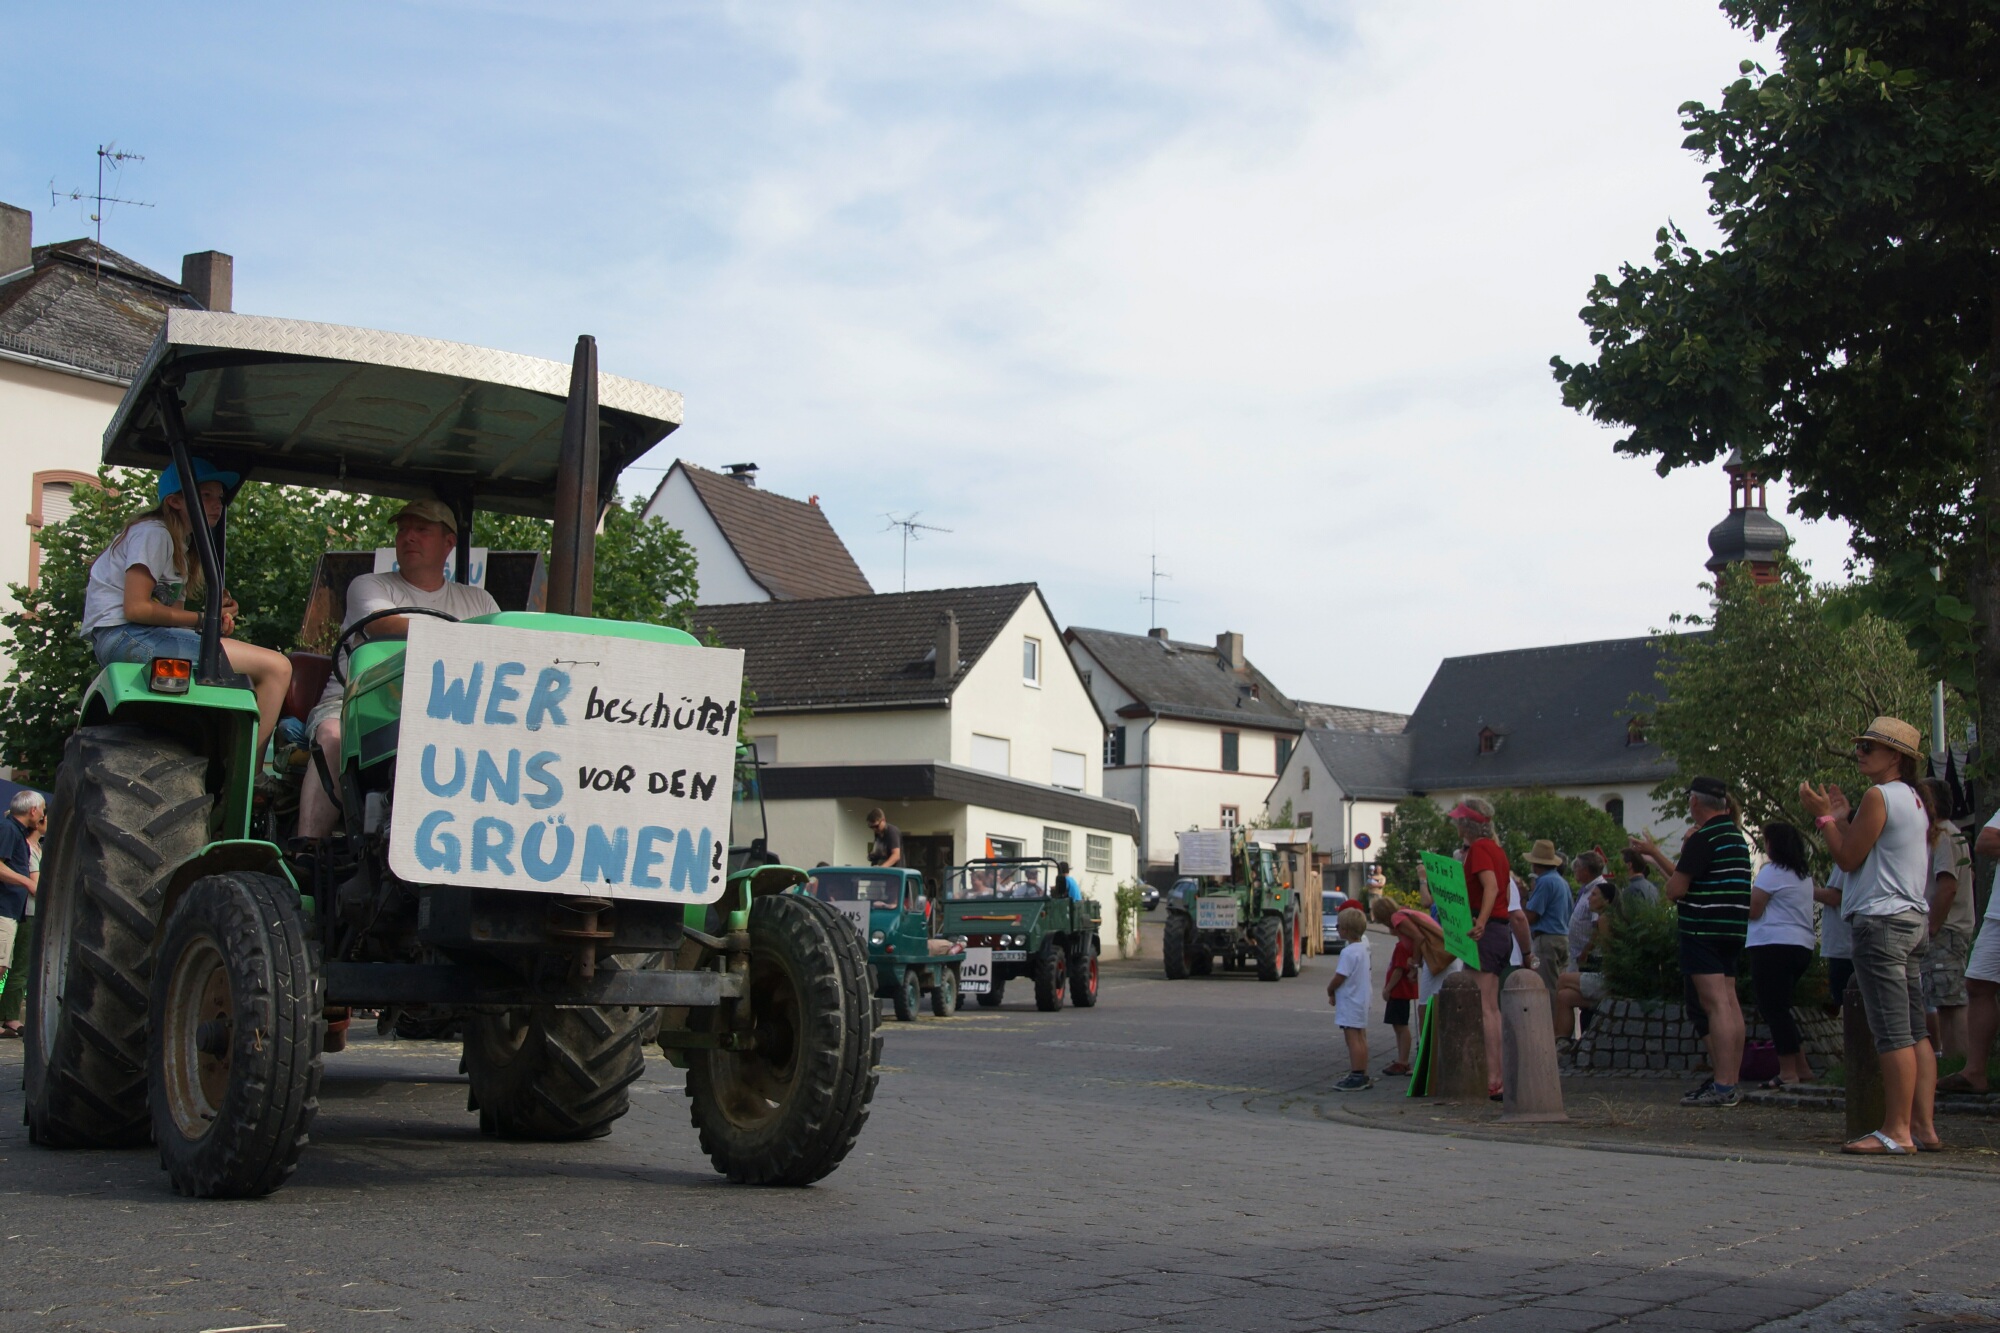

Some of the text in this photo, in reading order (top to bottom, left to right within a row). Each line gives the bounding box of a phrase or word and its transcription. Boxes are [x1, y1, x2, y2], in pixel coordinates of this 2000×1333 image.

[426, 659, 573, 731] WER
[420, 743, 717, 810] UNS VOR DEN
[961, 964, 988, 977] IND
